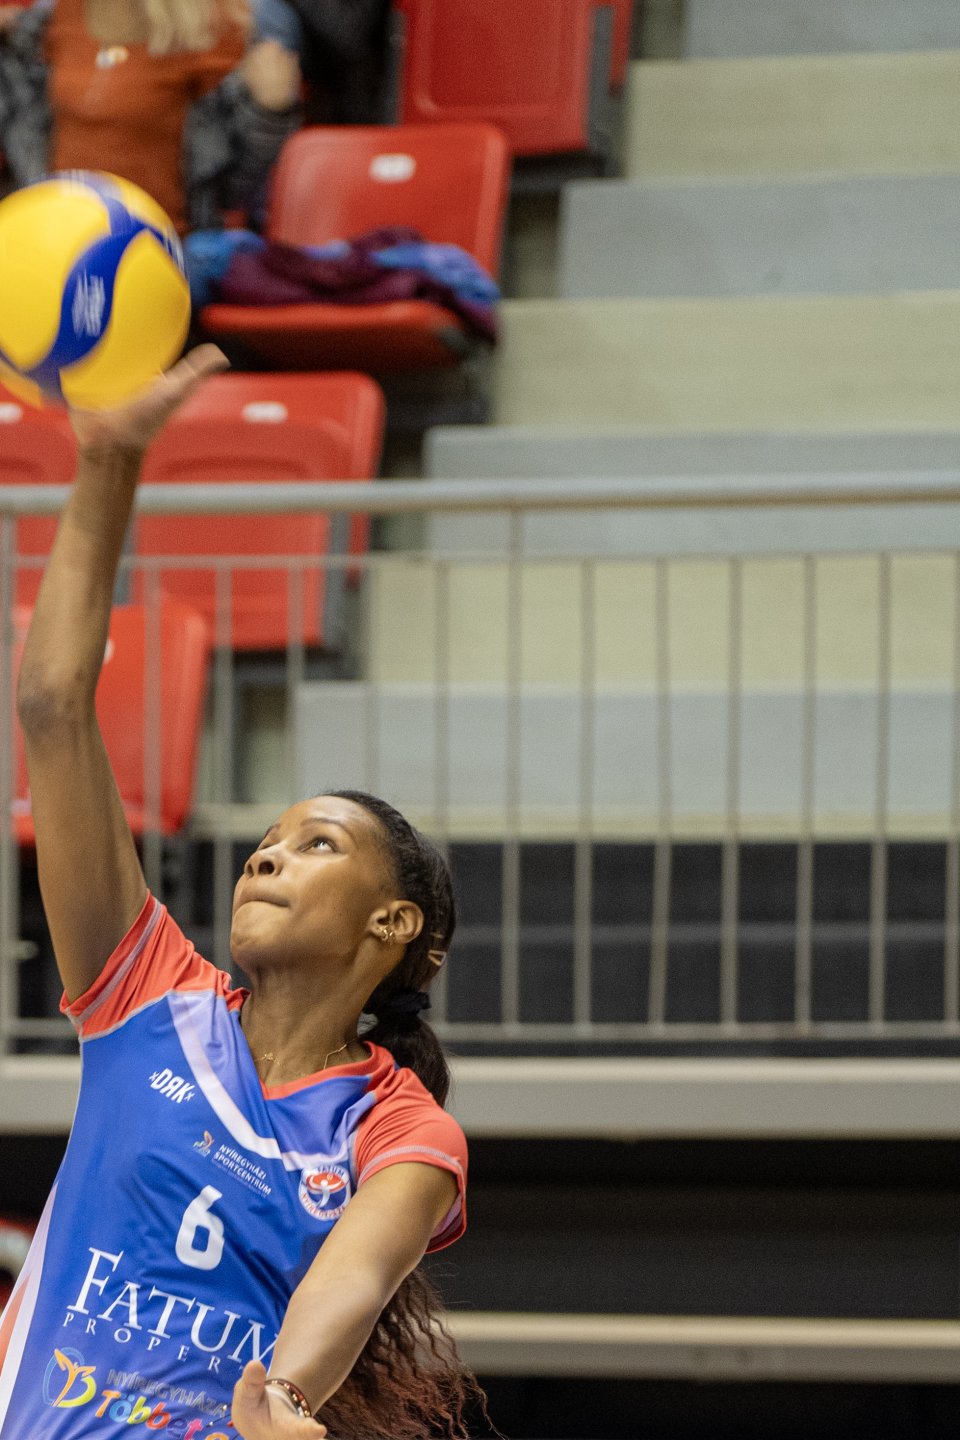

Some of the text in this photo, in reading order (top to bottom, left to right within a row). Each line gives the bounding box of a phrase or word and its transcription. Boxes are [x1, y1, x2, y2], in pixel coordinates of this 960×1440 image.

[214, 1151, 272, 1195] SPORTCENTRUM
[175, 1185, 225, 1271] 6
[62, 1311, 243, 1374] PROPER
